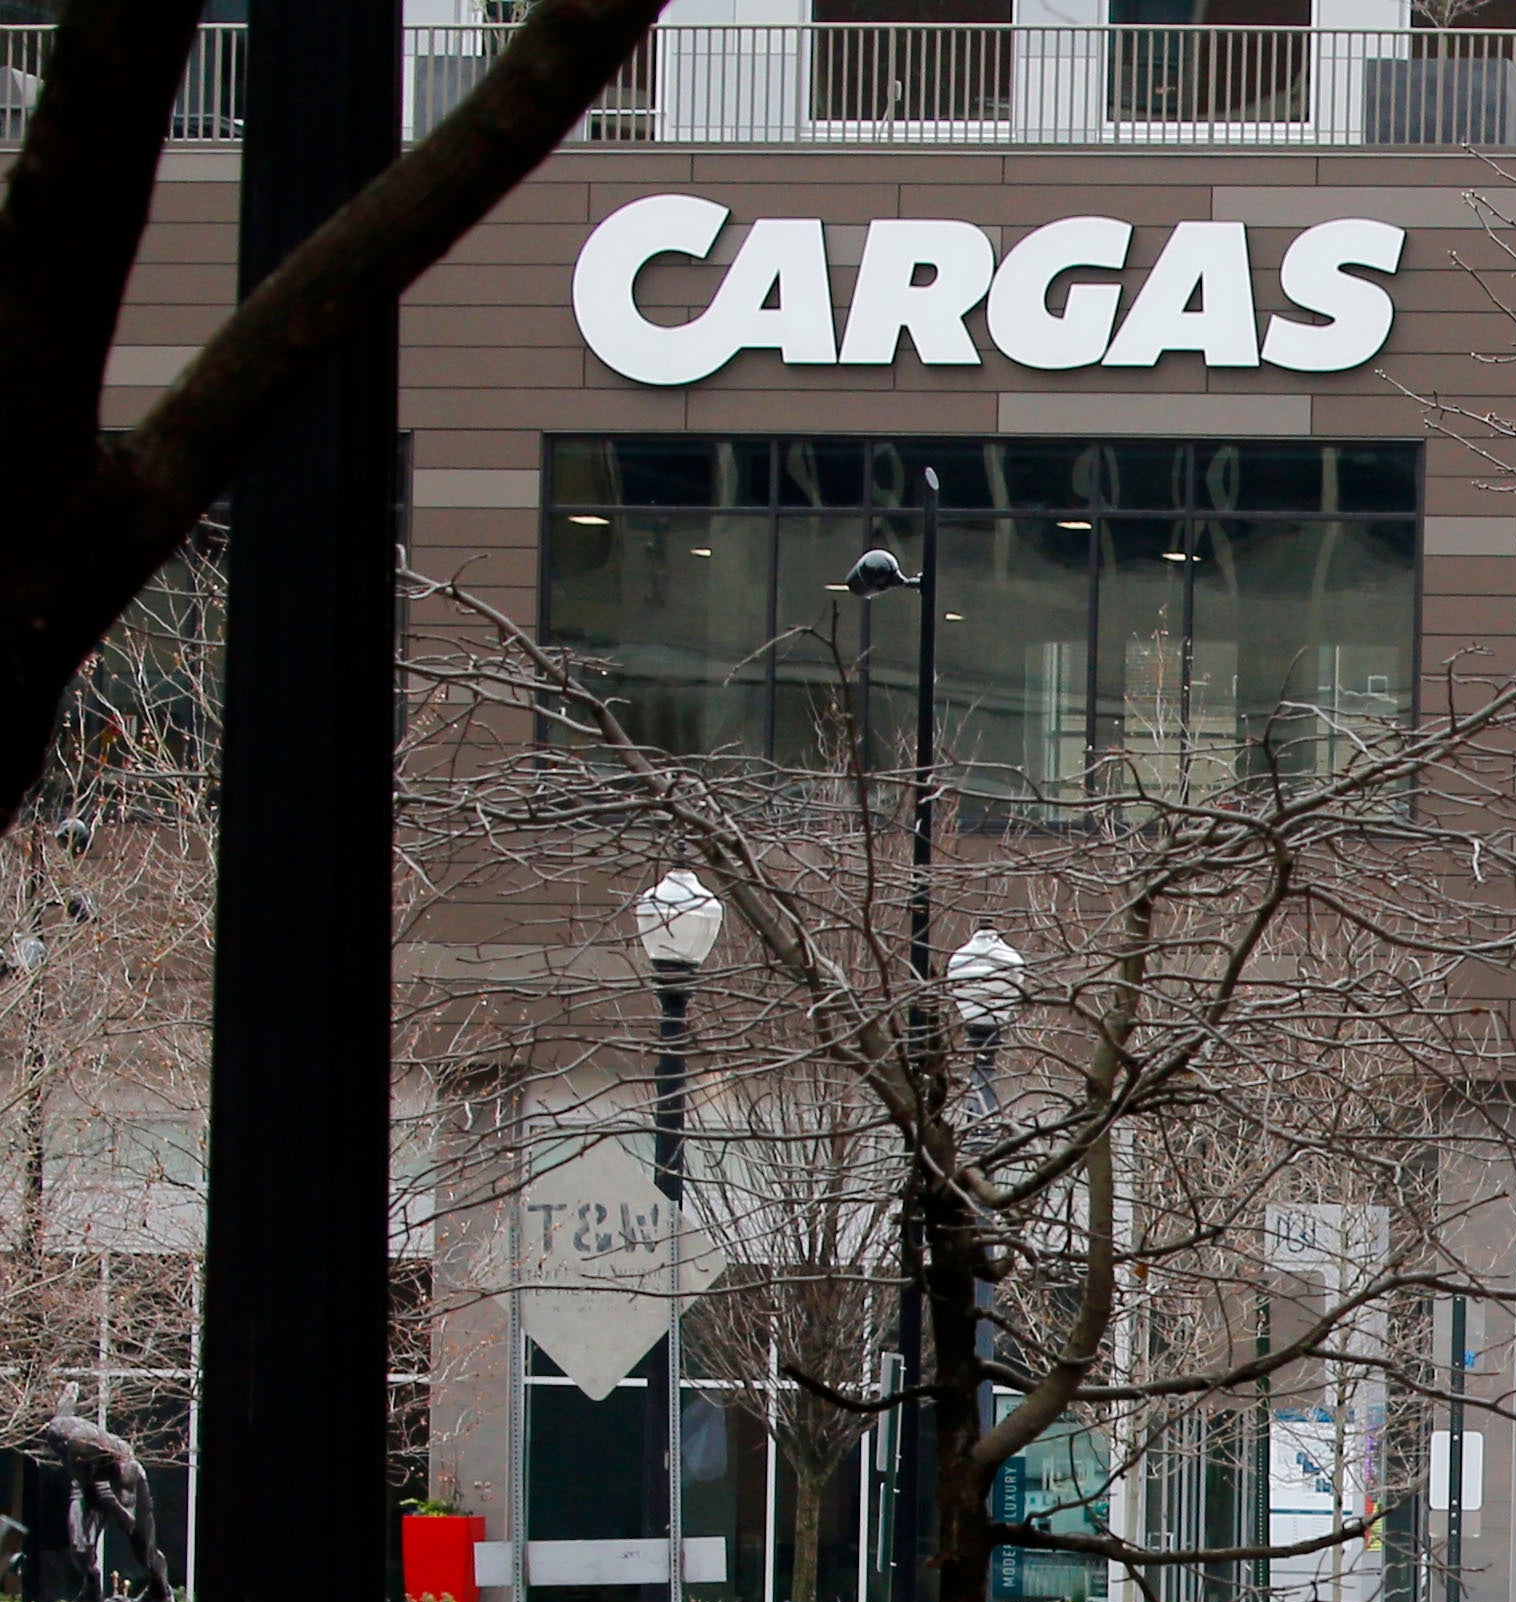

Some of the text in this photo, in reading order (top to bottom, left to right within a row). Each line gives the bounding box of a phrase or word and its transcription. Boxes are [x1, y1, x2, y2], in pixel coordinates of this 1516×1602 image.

[572, 194, 1405, 385] CARGAS
[527, 1203, 658, 1252] T&W
[1004, 1466, 1017, 1518] LUXURY
[1003, 1544, 1016, 1587] MODE
